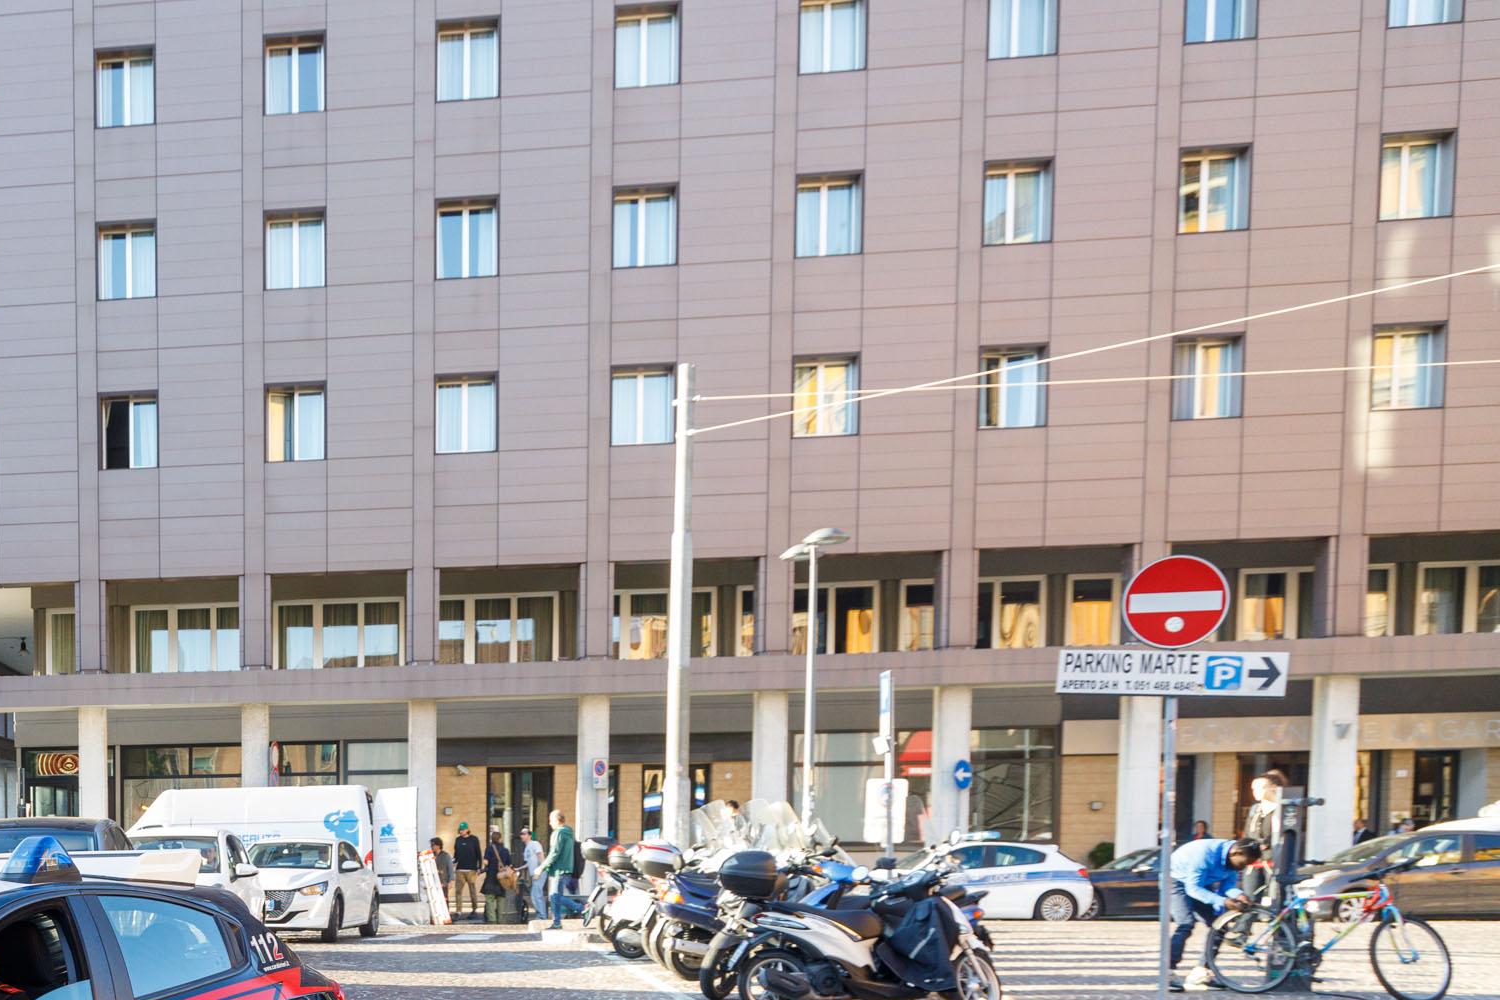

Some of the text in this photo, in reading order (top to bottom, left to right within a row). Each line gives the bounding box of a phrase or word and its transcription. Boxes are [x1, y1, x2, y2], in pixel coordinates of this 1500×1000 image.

[1063, 652, 1133, 674] PARKING
[1139, 653, 1200, 675] MART.E
[1061, 679, 1097, 690] APERTO
[1099, 680, 1111, 690] 24
[250, 931, 285, 964] 112
